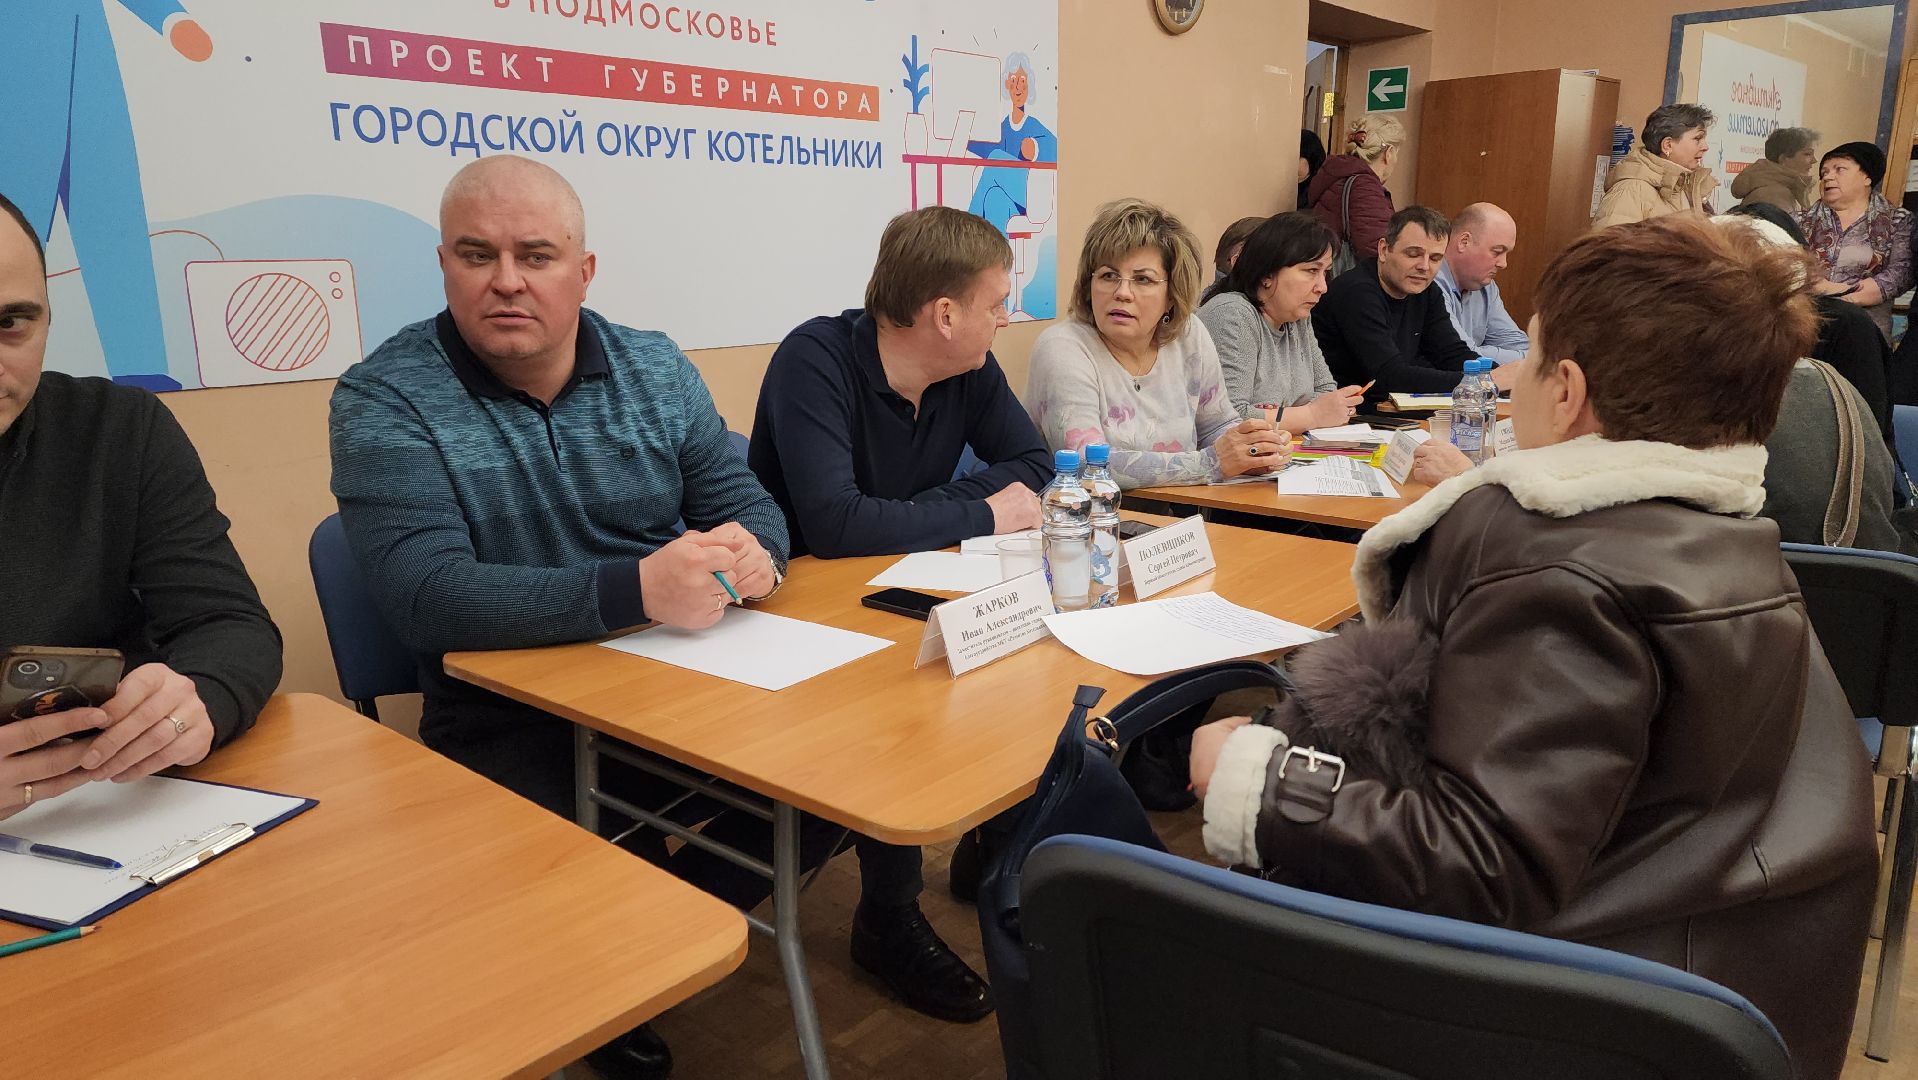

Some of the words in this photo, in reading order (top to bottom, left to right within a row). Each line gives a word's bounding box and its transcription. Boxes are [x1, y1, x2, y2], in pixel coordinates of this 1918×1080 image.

[347, 34, 553, 83] ПРОЕКТ
[603, 64, 872, 114] ГУБЕРНАТОРА
[329, 102, 585, 158] ГОРОДСКОЙ
[596, 122, 697, 160] ОКРУГ
[707, 129, 883, 169] КОТЕЛЬНИКИ
[1138, 531, 1196, 562] ПОЛЕВЩИКОВ
[1147, 560, 1171, 574] Сергей
[1169, 548, 1199, 565] Петрович
[972, 591, 1019, 618] ЖАРКОВ
[960, 627, 985, 642] Иван
[986, 604, 1043, 633] Александрович
